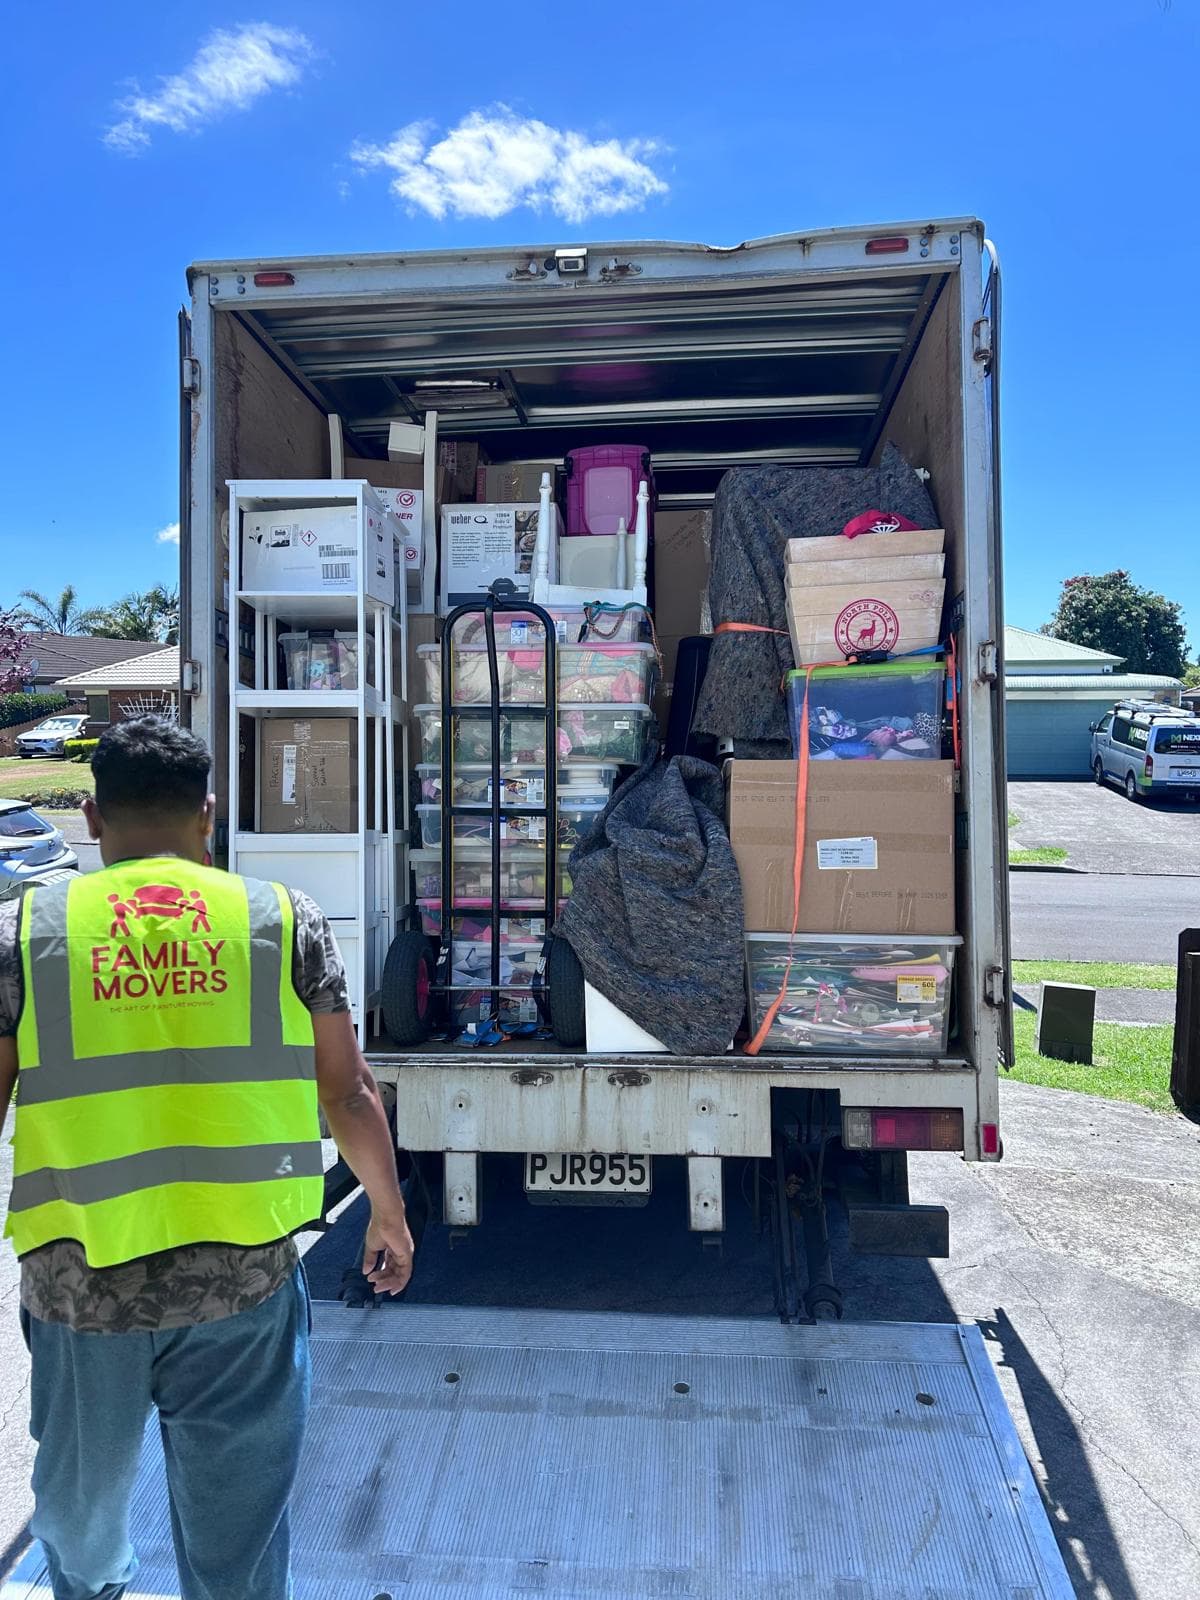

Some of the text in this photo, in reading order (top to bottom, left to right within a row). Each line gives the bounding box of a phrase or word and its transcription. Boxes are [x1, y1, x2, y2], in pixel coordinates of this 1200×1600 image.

[450, 514, 472, 525] weber
[842, 603, 893, 624] NORTH POLE
[91, 940, 226, 973] FAMILY
[93, 969, 228, 1002] MOVERS
[530, 1153, 646, 1186] PJR955
